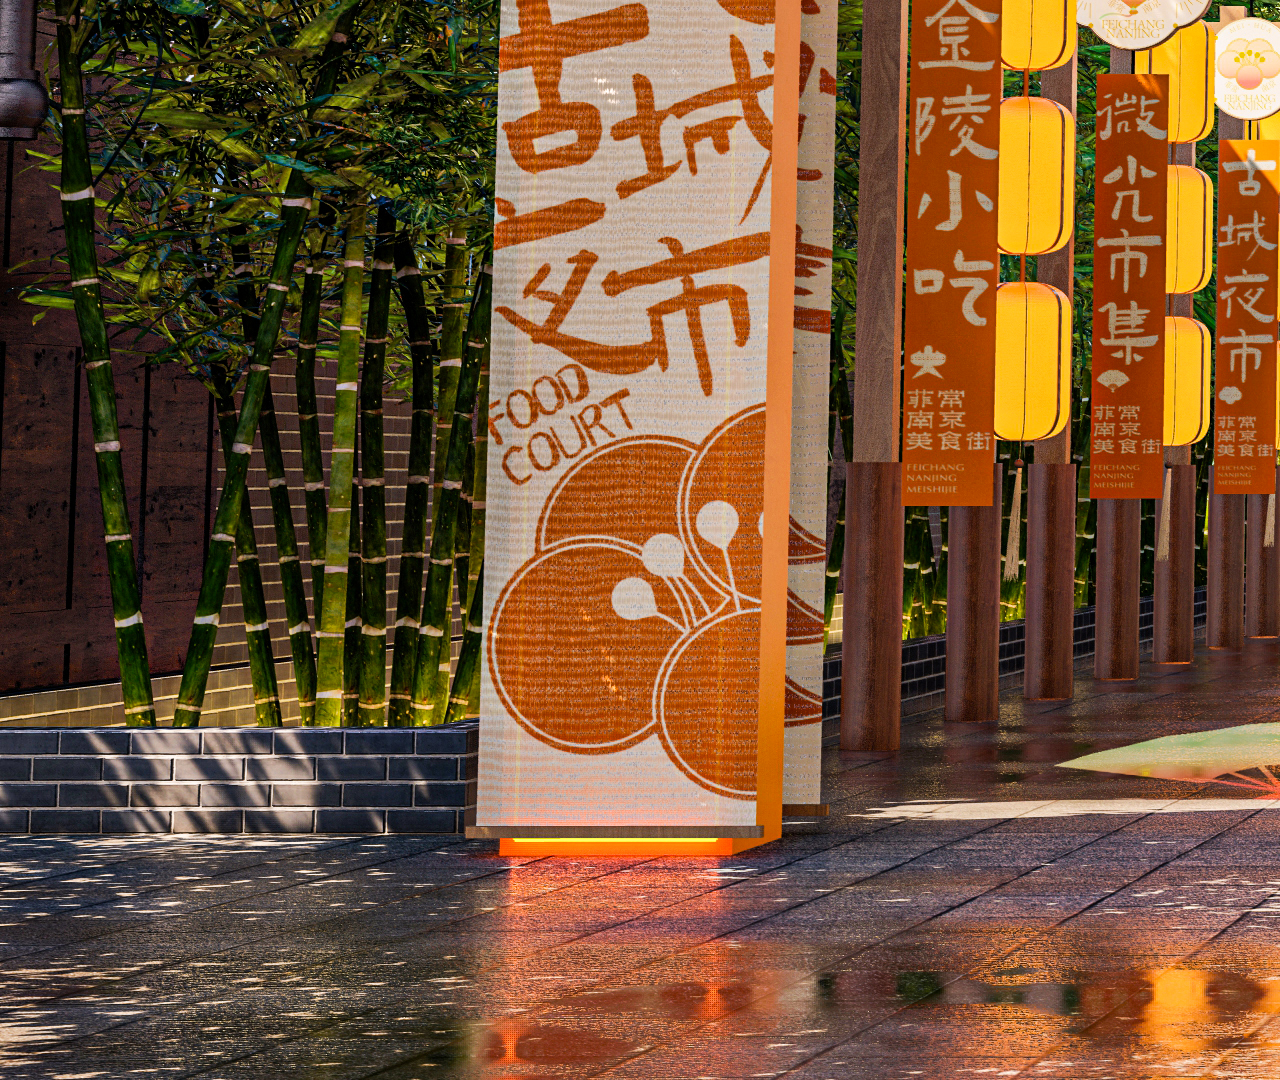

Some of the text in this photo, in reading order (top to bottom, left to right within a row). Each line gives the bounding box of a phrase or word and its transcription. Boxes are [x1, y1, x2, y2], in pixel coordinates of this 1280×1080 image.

[1101, 19, 1165, 30] FEICHANG
[1106, 29, 1161, 39] NANJING
[1223, 93, 1276, 103] FEICHANG
[1219, 149, 1278, 383] 古城夜市
[488, 363, 589, 445] FOOD
[906, 389, 965, 409] 菲常
[501, 388, 633, 487] COURT
[906, 431, 991, 451] 美食街
[1093, 438, 1161, 455] 美食街
[906, 463, 965, 471] FEICHANG
[906, 474, 957, 482] NANJING
[906, 485, 958, 494] MEISHIJIE
